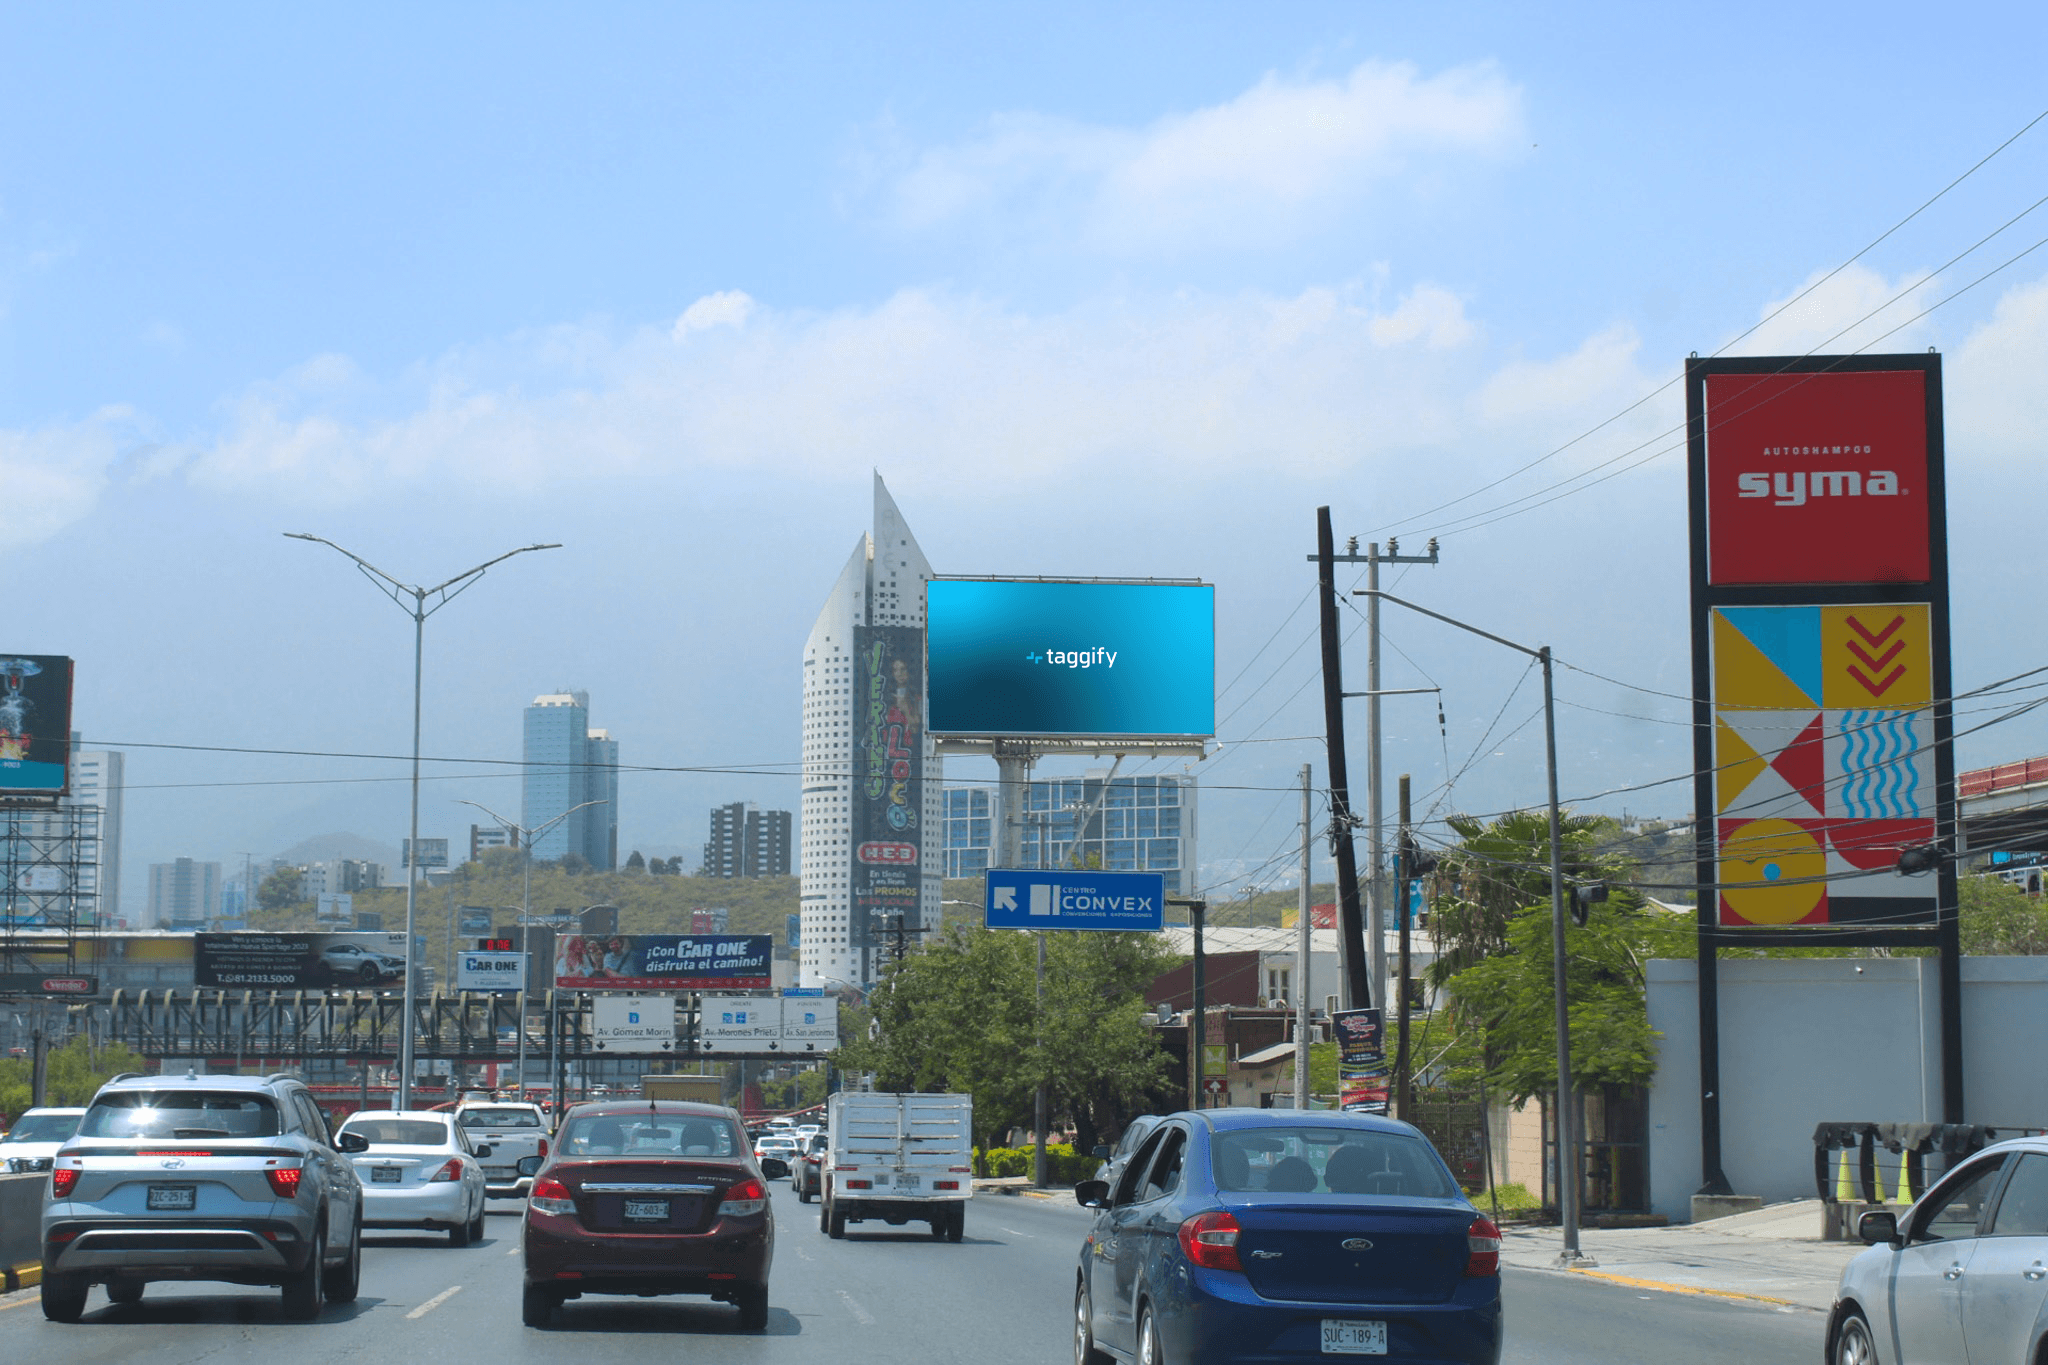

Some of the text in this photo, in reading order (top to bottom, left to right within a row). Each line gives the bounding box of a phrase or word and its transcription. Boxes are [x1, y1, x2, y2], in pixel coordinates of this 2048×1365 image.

[1763, 445, 1871, 456] AUTOSHAMPOO
[1738, 470, 1899, 506] syma
[1046, 647, 1118, 669] taggify
[869, 870, 880, 878] En
[874, 887, 917, 897] PROMOS
[1062, 895, 1153, 911] CONVEX
[646, 940, 748, 959] ¡Con CAR ONE
[466, 957, 518, 971] CAR ONE
[646, 955, 764, 972] disfruta el camino!
[235, 974, 295, 983] 81.2133.5000
[597, 1028, 611, 1036] Av.
[718, 1028, 752, 1037] Morones
[754, 1028, 777, 1037] Prieto
[796, 1028, 807, 1037] San
[1323, 1328, 1385, 1344] SUC-189-A
